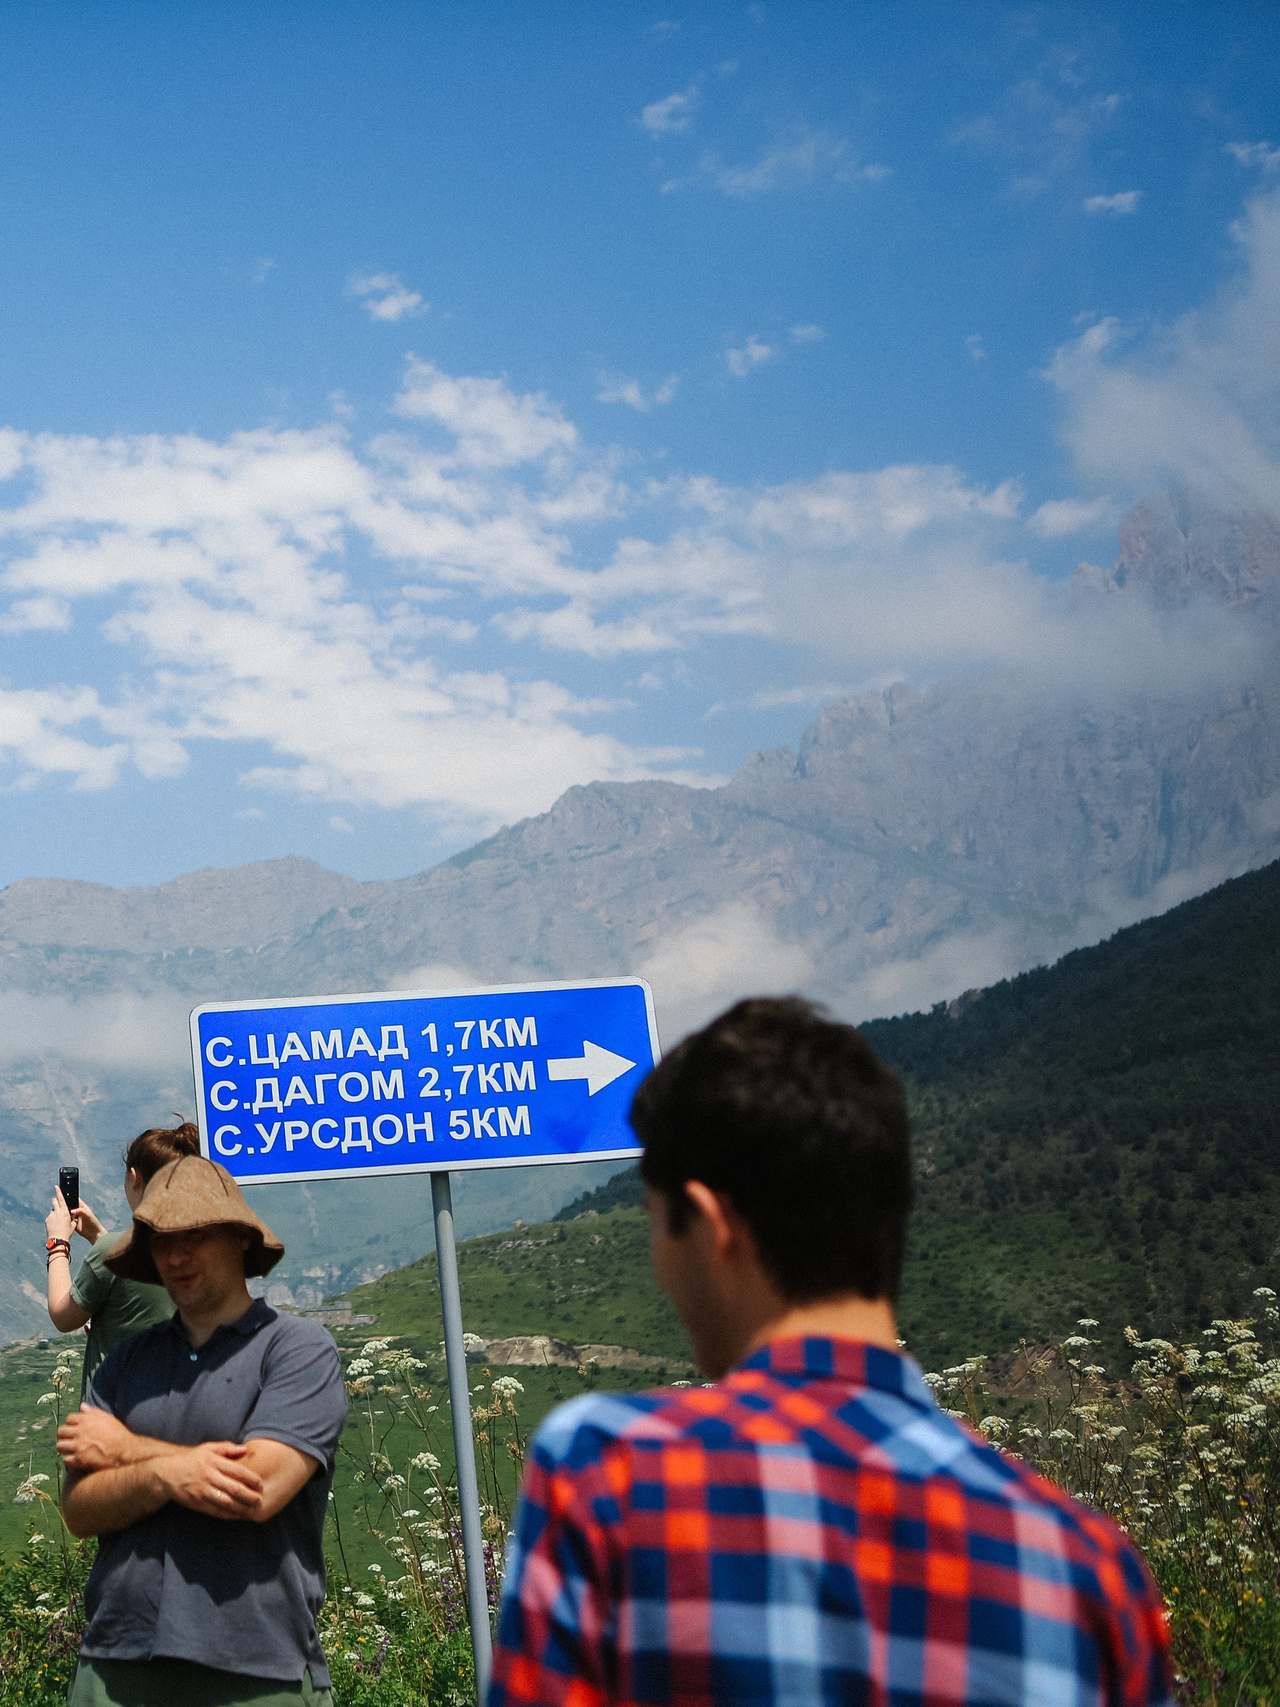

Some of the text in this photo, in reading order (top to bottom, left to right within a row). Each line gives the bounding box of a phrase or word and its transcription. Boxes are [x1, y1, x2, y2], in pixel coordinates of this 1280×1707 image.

[205, 1016, 538, 1069] С.ЦАМАД 1,7КМ
[210, 1060, 537, 1115] С.ДАГОМ 2,7КМ
[213, 1105, 532, 1156] С.УРСДОН 5КМ
